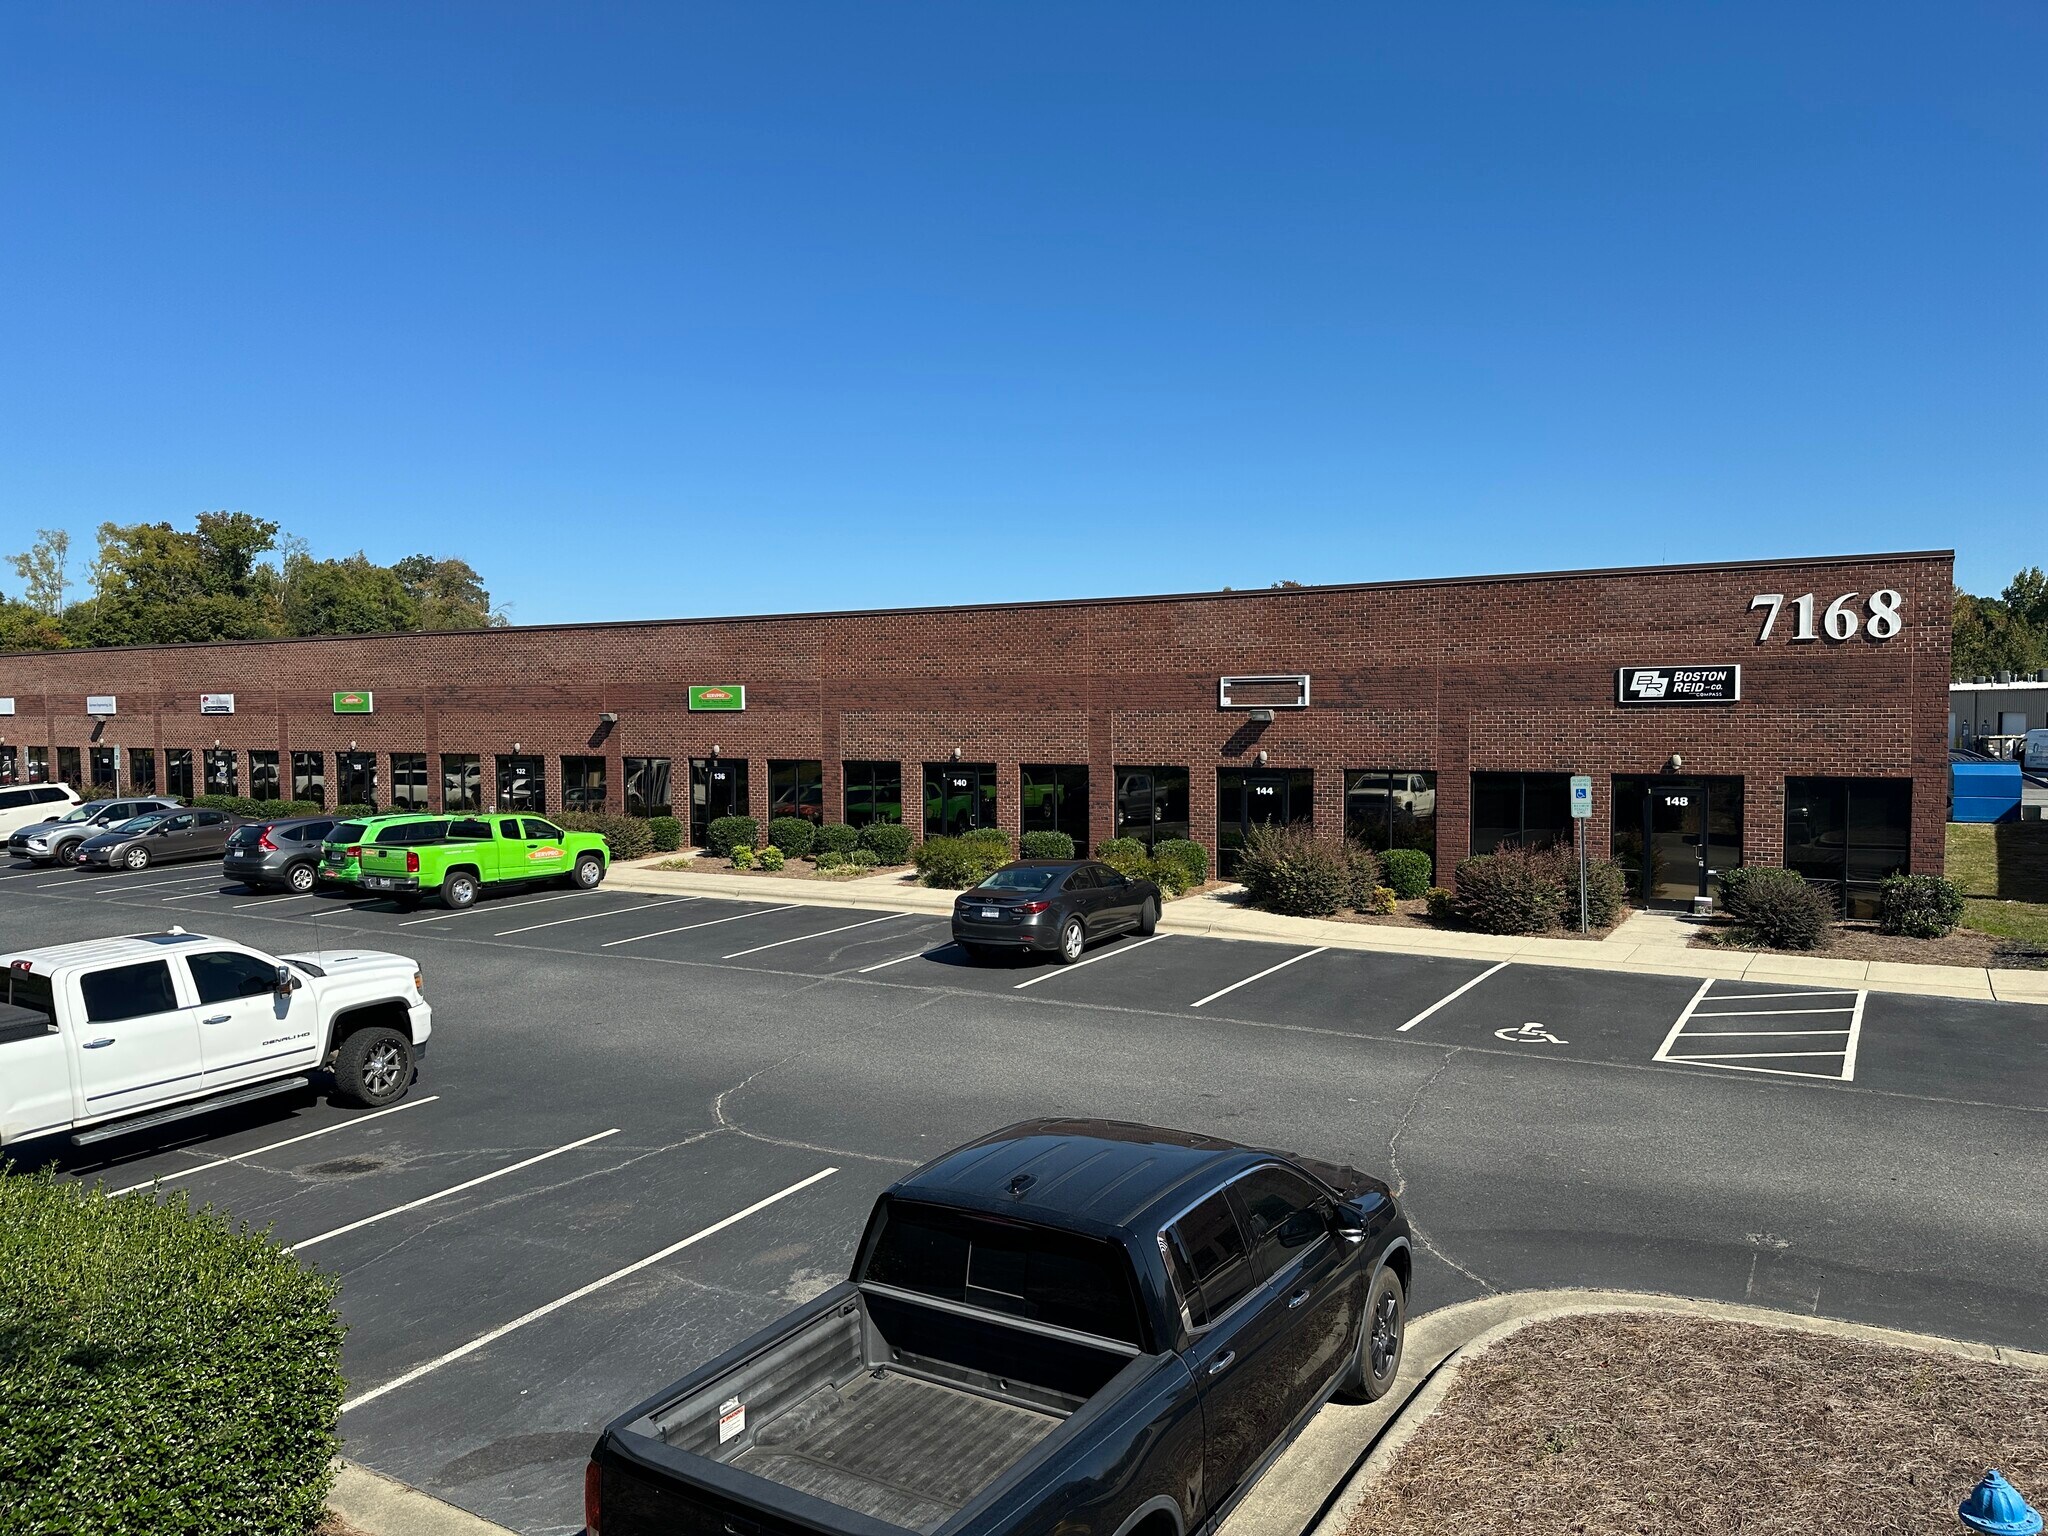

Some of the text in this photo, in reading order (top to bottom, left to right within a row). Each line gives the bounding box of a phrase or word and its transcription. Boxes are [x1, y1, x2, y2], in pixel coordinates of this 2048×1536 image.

[1750, 589, 1902, 641] 7168
[1673, 671, 1727, 682] BOSTON
[1673, 682, 1704, 693] REID
[714, 772, 726, 780] 136
[953, 778, 967, 787] 140
[1256, 786, 1274, 795] 144
[1665, 796, 1688, 807] 148
[534, 850, 559, 858] SERVPRO
[262, 1035, 296, 1045] DENALI
